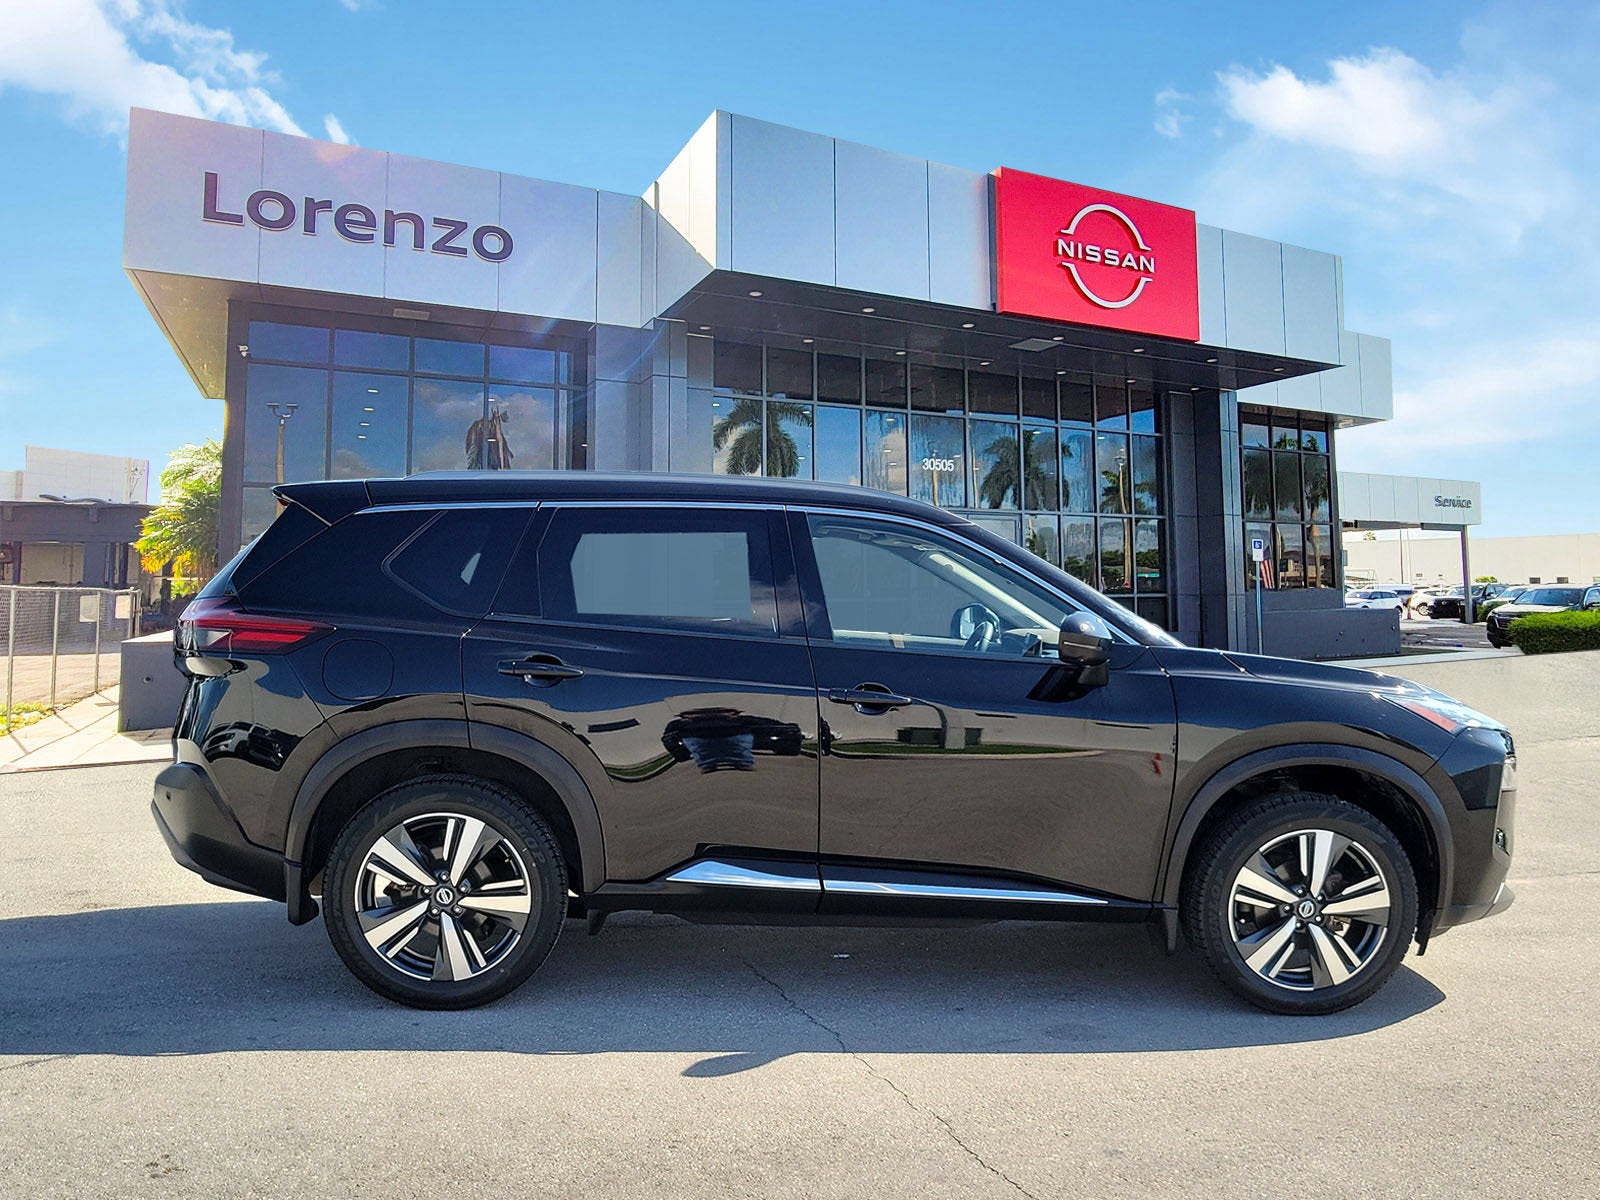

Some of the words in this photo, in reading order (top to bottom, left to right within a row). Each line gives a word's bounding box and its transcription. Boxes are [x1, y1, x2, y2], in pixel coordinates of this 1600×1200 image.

[202, 171, 515, 262] Lorenzo
[1057, 238, 1155, 273] NISSAN
[922, 457, 954, 471] 30505
[1434, 495, 1472, 508] Service
